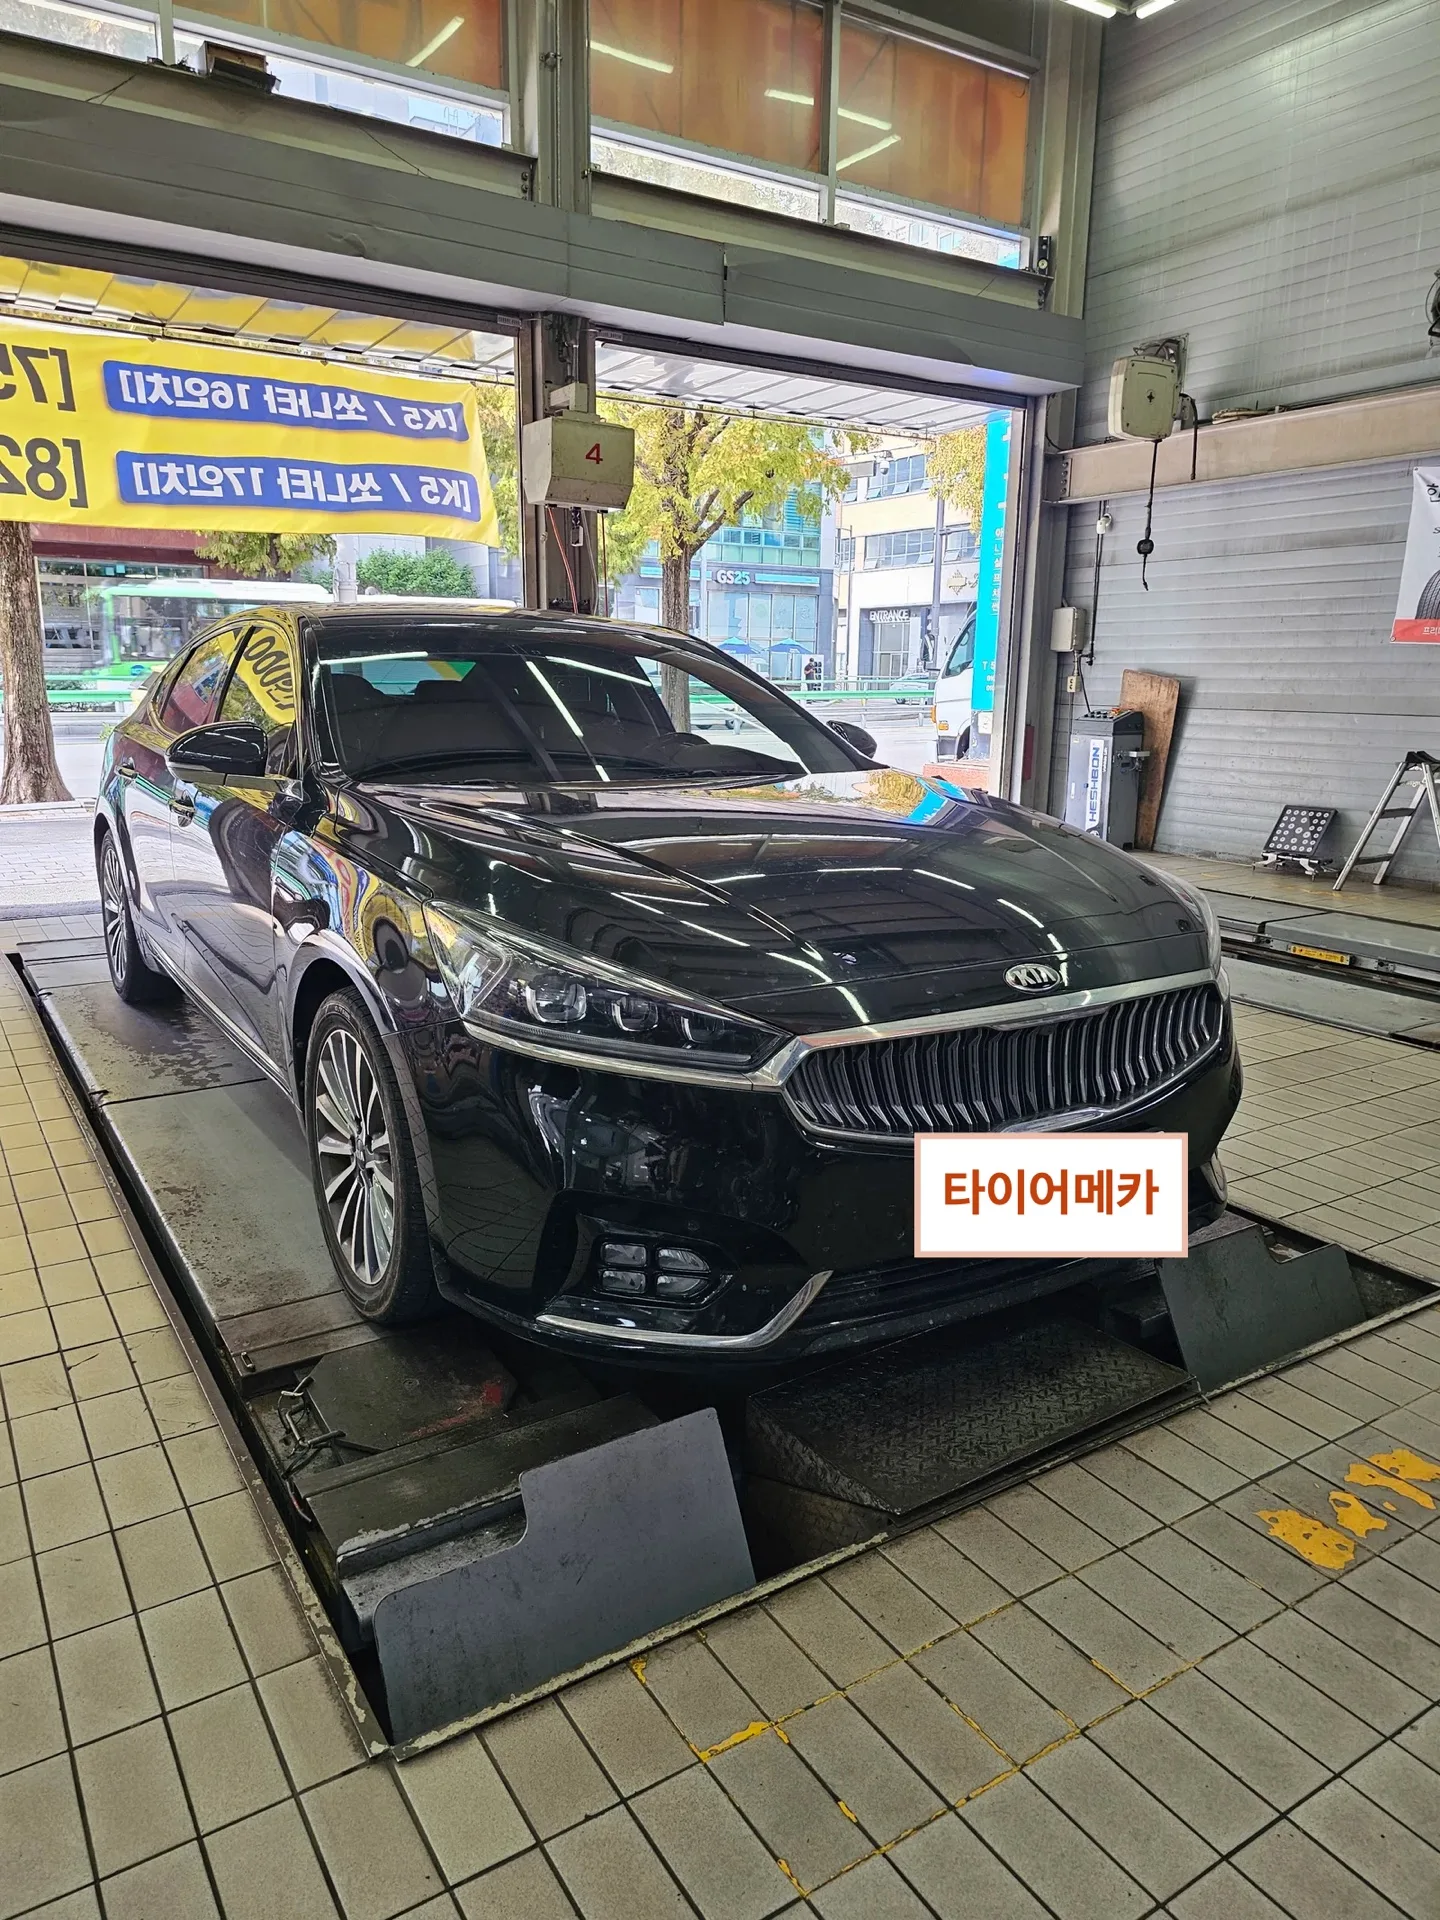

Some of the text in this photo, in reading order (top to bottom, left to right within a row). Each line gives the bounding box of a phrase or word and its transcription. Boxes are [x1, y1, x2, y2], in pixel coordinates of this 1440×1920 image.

[585, 443, 603, 465] 4
[717, 569, 750, 585] GS25
[869, 609, 909, 621] ENTRANCE
[1422, 626, 1440, 636] 프리
[1089, 747, 1100, 822] HESHBON
[1011, 966, 1057, 987] KIA
